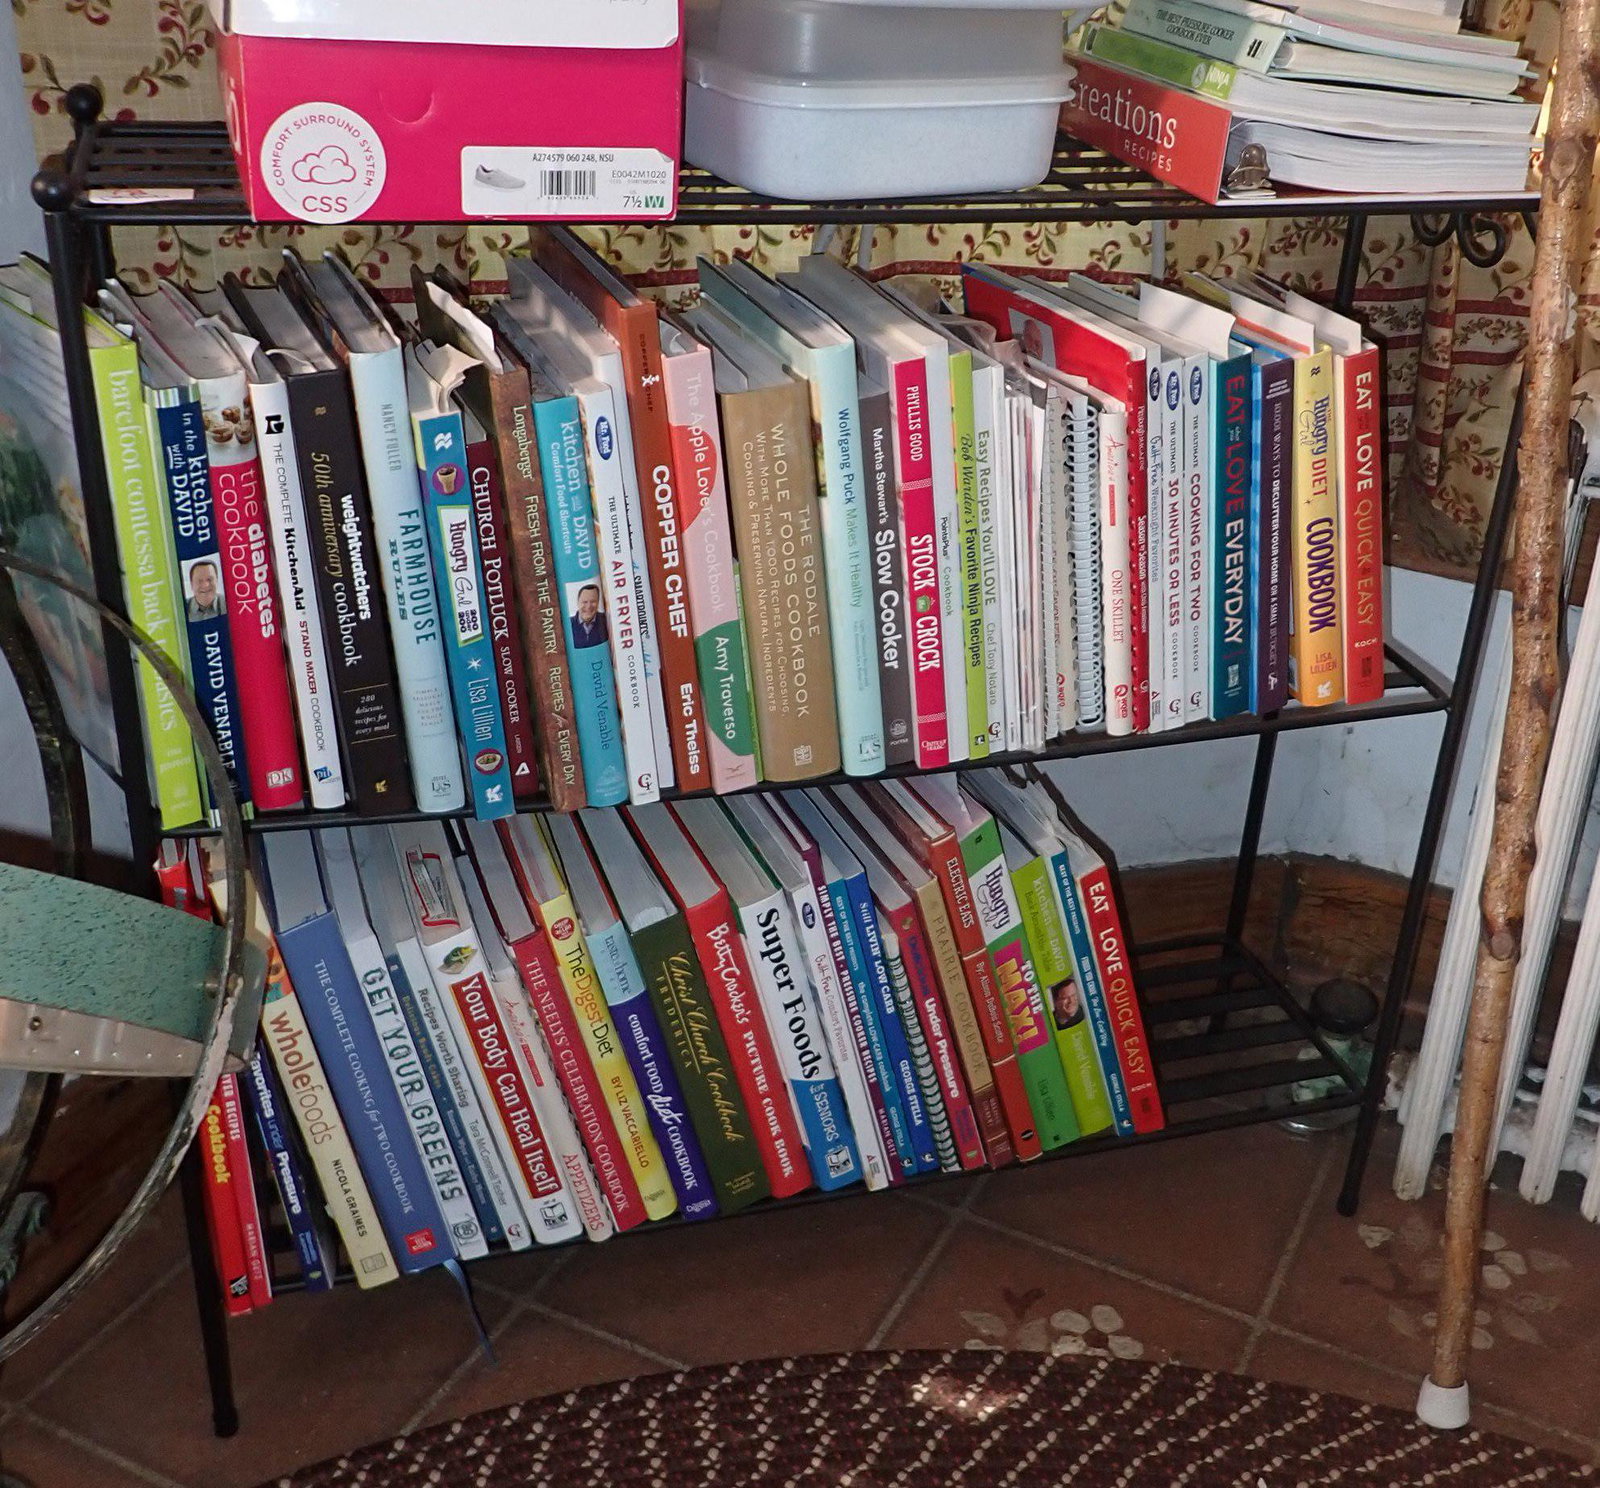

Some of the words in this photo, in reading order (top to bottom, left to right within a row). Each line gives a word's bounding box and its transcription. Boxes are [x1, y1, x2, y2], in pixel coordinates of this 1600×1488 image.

[1156, 9, 1168, 21] THE
[1168, 11, 1182, 26] BEST
[1181, 14, 1212, 34] PRESSURE
[1166, 25, 1196, 42] COOKBOOK
[1195, 32, 1213, 46] EVER
[1206, 64, 1230, 88] NINJA
[1070, 80, 1177, 149] reations
[271, 128, 293, 186] COMFORT
[293, 114, 361, 138] SURROUND
[359, 139, 375, 187] SYSTEM
[532, 153, 564, 162] A274579
[566, 153, 580, 162] 060
[599, 153, 614, 162] NSU
[1124, 139, 1173, 172] RECIPES
[612, 170, 666, 179] E0042M1020
[302, 195, 348, 213] CSS
[644, 196, 665, 208] W
[906, 384, 921, 431] PHYLLIS
[1356, 371, 1372, 410] EAT
[380, 403, 394, 434] NANCY
[1312, 394, 1330, 456] Hungry
[273, 443, 284, 464] THE
[385, 435, 402, 472] FULLER
[550, 442, 562, 484] Comfort
[770, 423, 790, 502] WHOLE
[872, 428, 886, 471] Martha
[910, 432, 922, 462] GOOD
[961, 433, 973, 462] Bob
[1356, 432, 1374, 492] LOVE
[240, 468, 259, 518] the
[312, 452, 334, 490] 50th
[962, 465, 976, 524] Warden's
[1311, 458, 1328, 497] DIET
[277, 467, 294, 525] COMPLETE
[472, 466, 497, 550] CHURCH
[556, 484, 566, 508] Food
[608, 496, 616, 510] THE
[652, 464, 680, 570] COPPER
[876, 472, 888, 525] Stewart's
[318, 494, 344, 578] anniversary
[559, 508, 572, 554] Shortcuts
[610, 512, 622, 554] ULTIMATE
[779, 511, 798, 586] FOODS
[798, 504, 812, 546] THE
[1354, 500, 1373, 568] QUICK
[284, 527, 306, 611] KitchenAid
[341, 494, 372, 620] weightwatchers
[398, 508, 436, 644] FARMHOUSE
[612, 560, 626, 589] AIR
[875, 528, 892, 585] Slow
[910, 533, 936, 590] STOCK
[966, 527, 976, 580] Favorite
[1306, 517, 1337, 634] COOKBOOK
[248, 523, 276, 639] diabetes
[388, 538, 408, 620] RULES
[484, 556, 510, 642] POTLUCK
[801, 554, 820, 638] RODALE
[968, 584, 978, 616] Ninja
[1112, 569, 1124, 596] ONE
[1357, 576, 1374, 626] EASY
[332, 582, 362, 668] cookbook
[616, 594, 634, 648] FRYER
[665, 576, 688, 638] CHEF
[880, 590, 902, 670] Cooker
[1112, 596, 1125, 644] SKILLET
[299, 620, 312, 658] STAND
[500, 646, 514, 676] SLOW
[714, 636, 730, 672] Amy
[786, 594, 810, 718] COOKBOOK
[916, 615, 940, 672] CROCK
[970, 618, 980, 668] Recipes
[1315, 652, 1332, 664] LISA
[1354, 638, 1378, 648] KOCH
[306, 661, 318, 696] MIXER
[590, 660, 608, 702] David
[628, 655, 640, 708] COOKBOOK
[1310, 661, 1338, 675] LILLIEN
[355, 704, 384, 715] delicious
[505, 680, 520, 724] COOKER
[680, 683, 692, 718] Eric
[718, 674, 736, 740] Traverso
[310, 697, 326, 752] COOKBOOK
[597, 702, 610, 751] Venable
[682, 718, 700, 775] Theiss
[818, 885, 834, 918] SIMPLY
[859, 902, 872, 924] Still
[946, 856, 968, 904] ELECTRIC
[958, 902, 975, 930] EATS
[985, 864, 1012, 930] Hungry
[1089, 882, 1110, 914] EAT
[706, 922, 740, 971] Betty
[756, 906, 796, 992] Super
[827, 918, 838, 940] THE
[832, 940, 846, 962] BEST
[865, 924, 882, 957] LIVIN'
[1099, 926, 1124, 976] LOVE
[840, 970, 858, 1012] PRESSURE
[874, 960, 888, 985] LOW
[1021, 960, 1034, 982] TO
[462, 975, 490, 1022] Your
[720, 968, 752, 1025] Crocker's
[880, 984, 896, 1014] CARB
[1027, 984, 1044, 1014] THE
[1110, 978, 1136, 1032] QUICK
[418, 988, 440, 1030] Recipes
[436, 1030, 452, 1066] Worth
[448, 1067, 469, 1108] Sharing
[478, 1022, 510, 1070] Body
[628, 1013, 654, 1060] comfort
[782, 994, 822, 1080] Foods
[852, 1014, 868, 1049] COOKER
[924, 996, 944, 1038] Under
[936, 1038, 960, 1098] Pressure
[1124, 1036, 1146, 1074] EASY
[270, 1010, 337, 1145] wholefoods
[362, 966, 400, 1017] GET
[382, 1025, 425, 1102] YOUR
[411, 1104, 465, 1201] GREENS
[526, 956, 544, 990] THE
[538, 990, 571, 1046] NEELYS'
[560, 1050, 604, 1144] CELEBRATION
[596, 1144, 630, 1213] COOKBOOK
[644, 1059, 665, 1094] FOOD
[743, 1030, 769, 1094] PICTURE
[861, 1049, 878, 1084] RECIPES
[314, 958, 332, 988] THE
[324, 988, 356, 1052] COMPLETE
[348, 1052, 376, 1108] COOKING
[364, 1108, 379, 1124] for
[373, 1122, 392, 1151] TWO
[384, 1152, 416, 1214] COOKBOOK
[496, 1072, 520, 1108] Can
[646, 1092, 684, 1125] diet
[809, 1083, 825, 1095] for
[900, 1059, 916, 1097] GEORGE
[908, 1095, 924, 1126] STELLA
[225, 1100, 241, 1141] RECIPES
[510, 1107, 542, 1148] Heal
[761, 1096, 781, 1137] COOK
[814, 1091, 840, 1142] SENIORS
[525, 1147, 560, 1193] Itself
[667, 1125, 698, 1190] COOKBOOK
[774, 1138, 794, 1178] BOOK
[331, 1158, 351, 1195] NICOLA
[344, 1195, 368, 1238] GRAIMES
[562, 1153, 604, 1232] APPETIZERS
